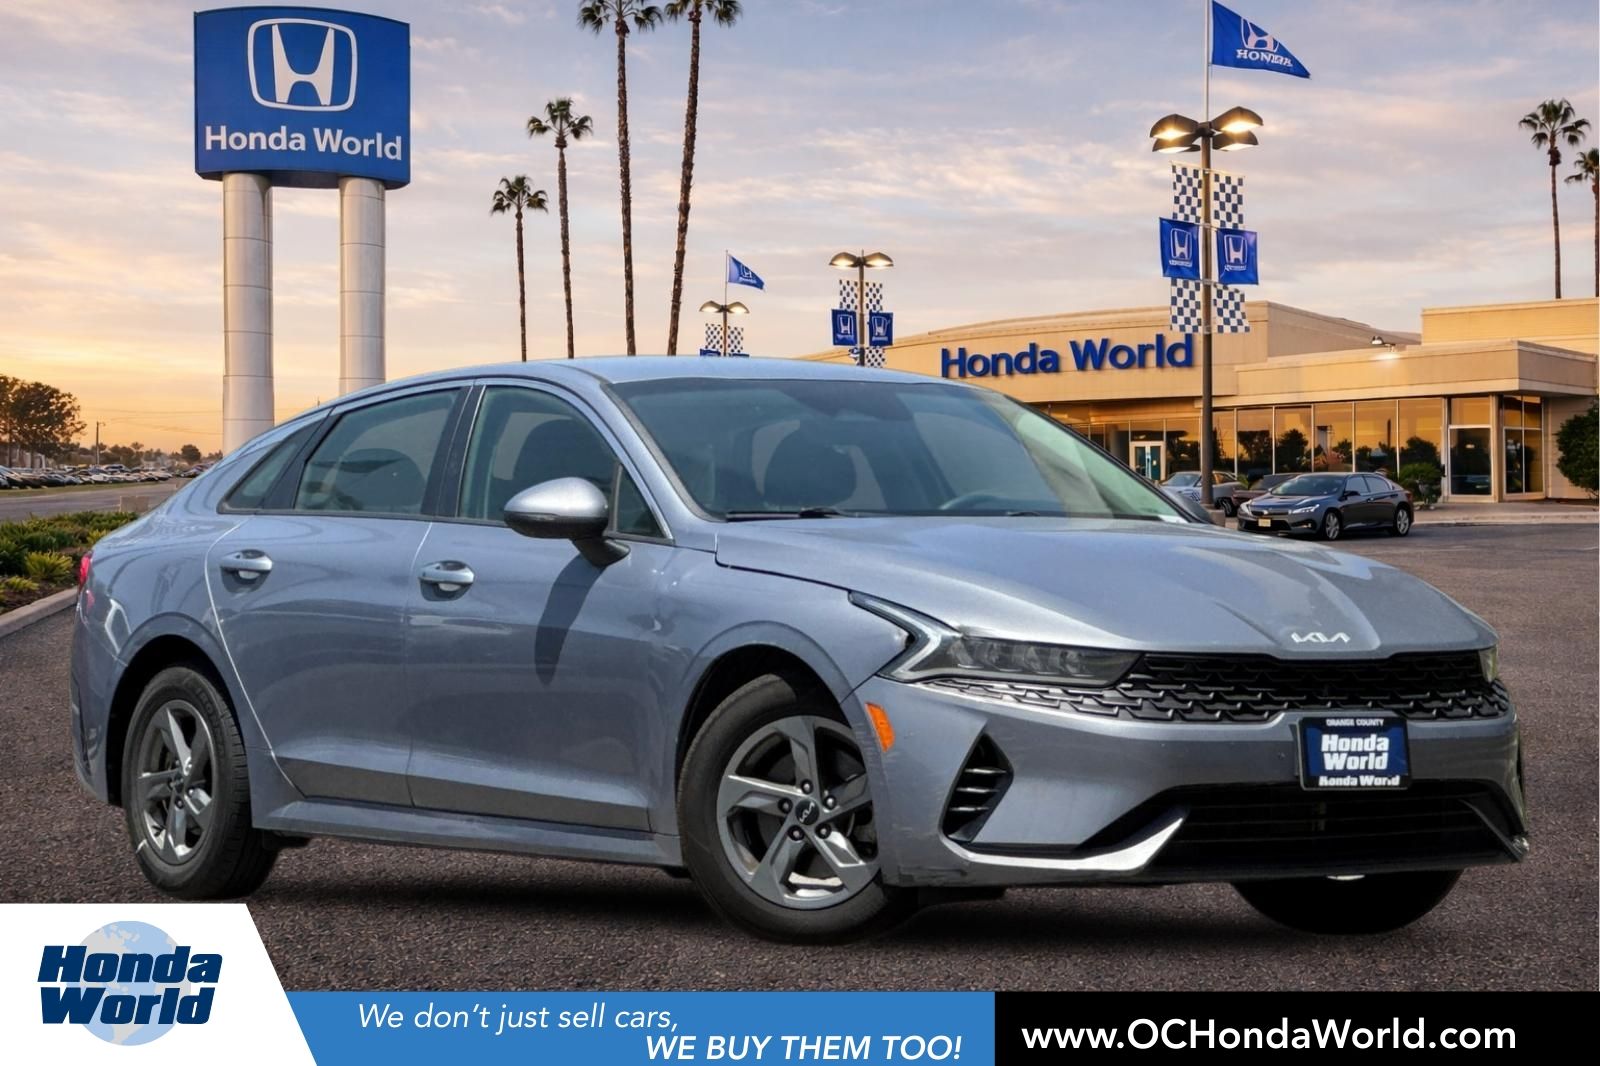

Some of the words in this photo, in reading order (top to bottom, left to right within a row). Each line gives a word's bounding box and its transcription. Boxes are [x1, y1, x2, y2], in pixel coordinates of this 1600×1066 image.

[205, 125, 306, 151] Honda
[314, 127, 402, 161] World
[941, 342, 1060, 378] Honda
[1070, 333, 1193, 370] World
[1291, 631, 1350, 644] KIA
[1326, 719, 1355, 727] ORANGE
[1356, 718, 1385, 727] COUNTY
[1321, 733, 1390, 752] Honda
[1323, 752, 1389, 771] World
